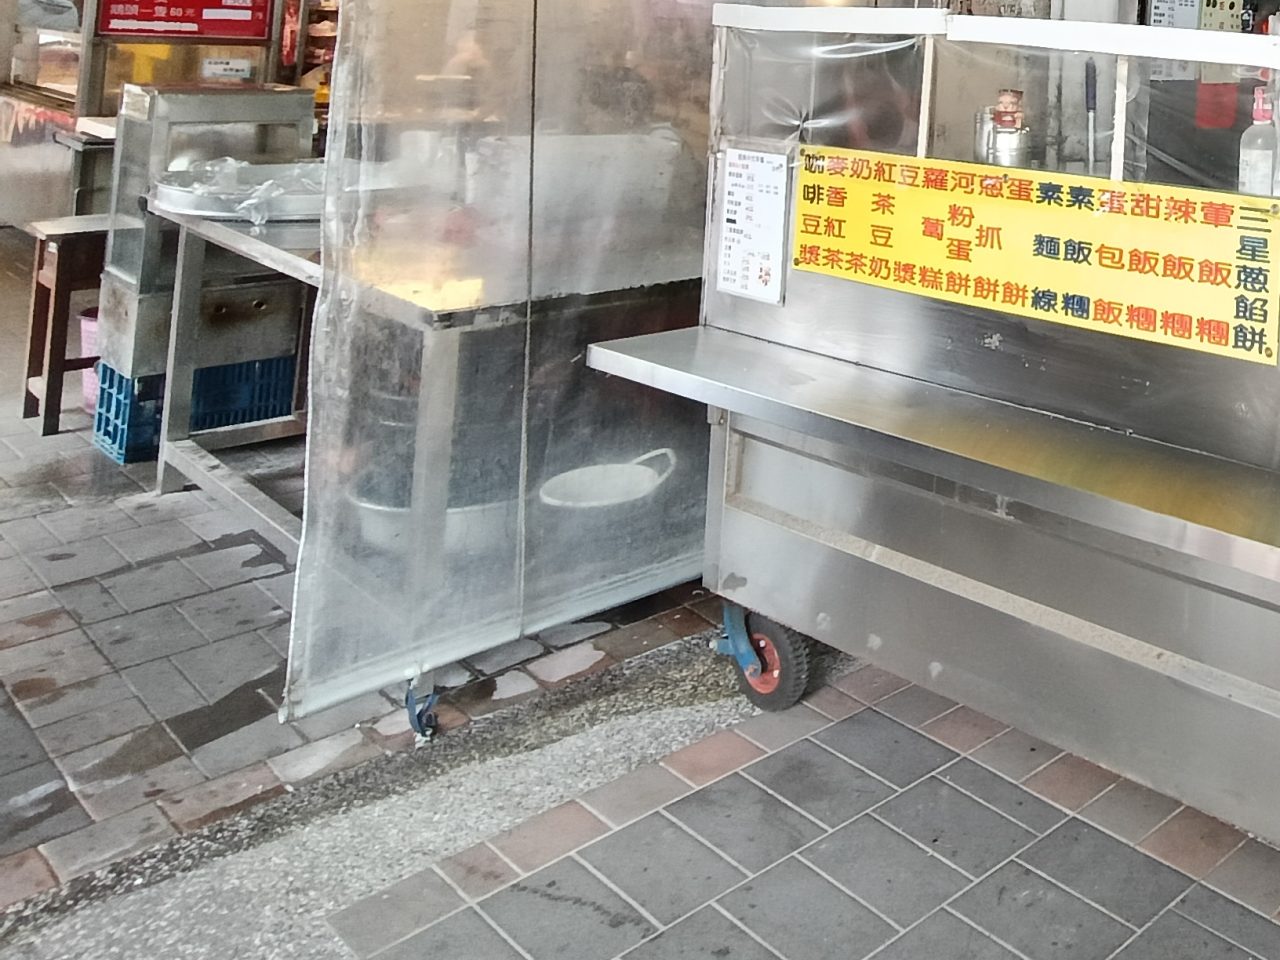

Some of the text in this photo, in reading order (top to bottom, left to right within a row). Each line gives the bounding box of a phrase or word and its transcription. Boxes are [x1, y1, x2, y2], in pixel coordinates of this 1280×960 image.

[822, 156, 848, 269] 麥香紅茶
[845, 158, 872, 274] 奶茶
[869, 161, 897, 280] 紅茶豆奶
[894, 165, 920, 285] 豆漿
[946, 171, 976, 295] 河粉蛋餅
[1003, 177, 1033, 307] 蛋餅
[1031, 182, 1064, 313] 素麵線
[1061, 186, 1094, 319] 素飯糰
[1126, 194, 1162, 332] 甜飯糰
[1160, 197, 1197, 339] 辣飯糰
[1196, 202, 1234, 346] 葷飯糰
